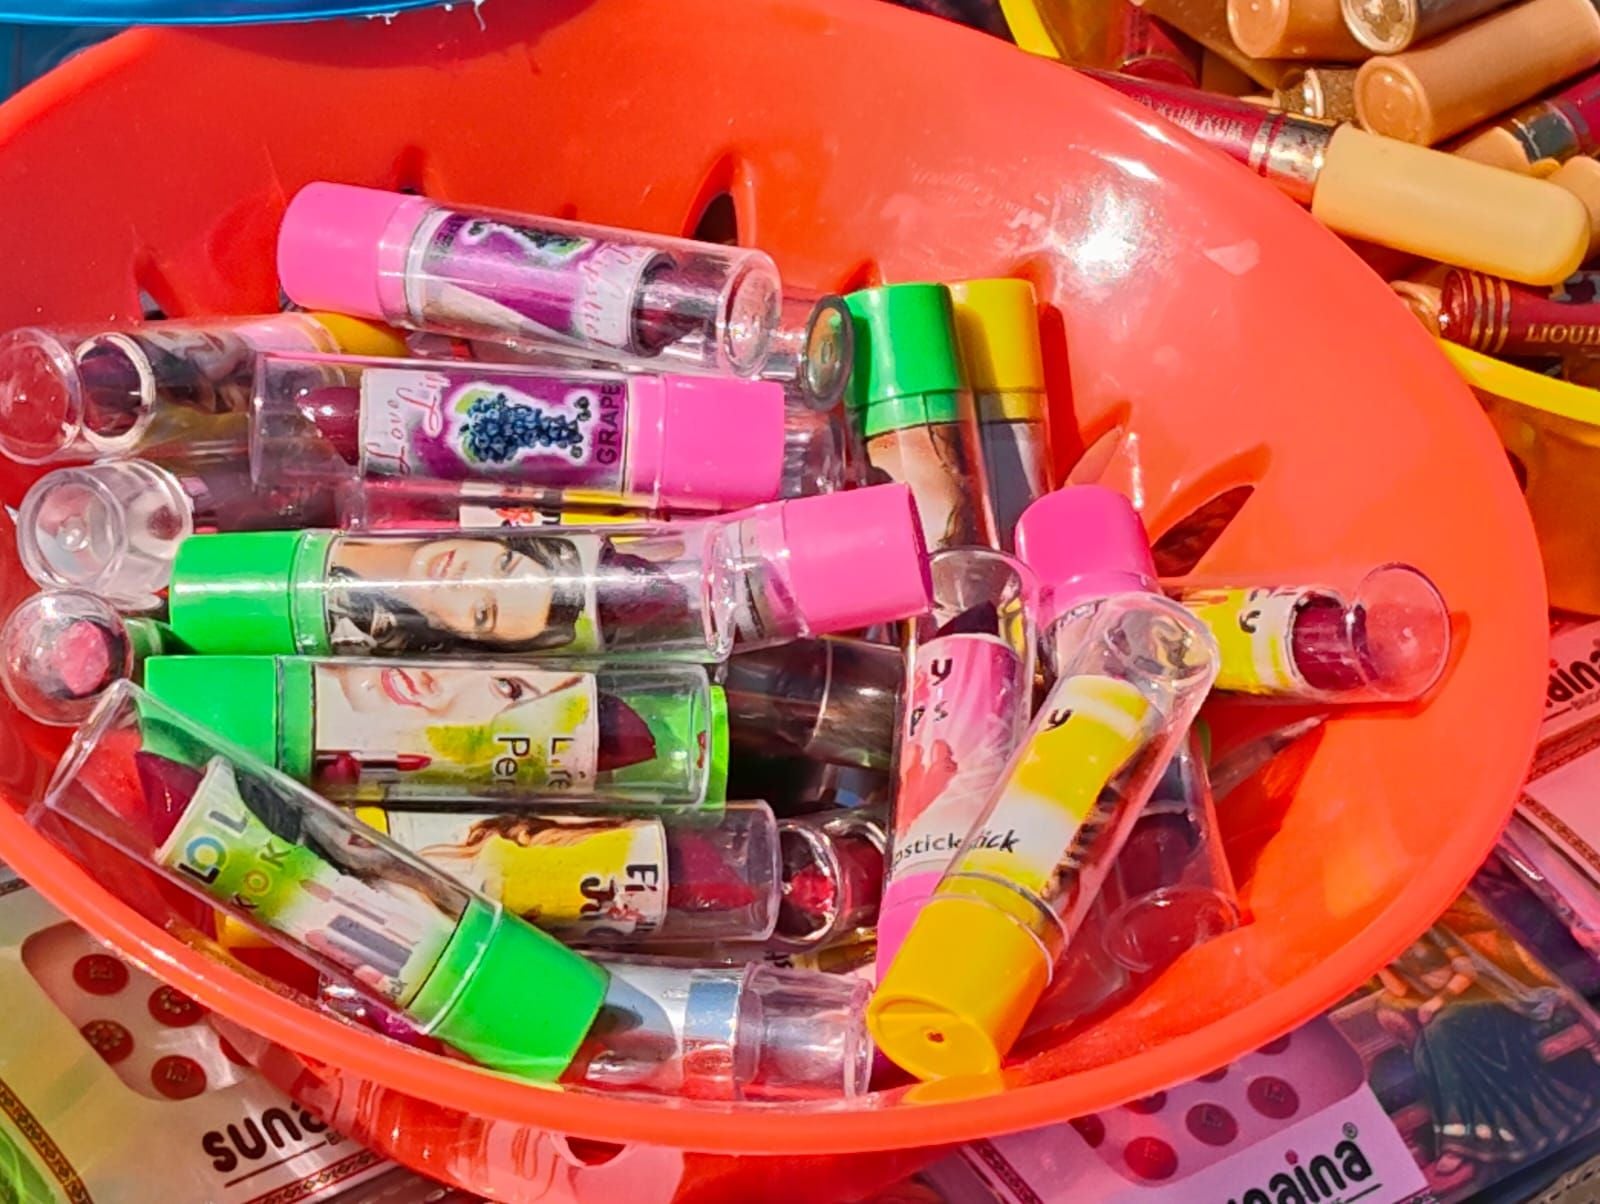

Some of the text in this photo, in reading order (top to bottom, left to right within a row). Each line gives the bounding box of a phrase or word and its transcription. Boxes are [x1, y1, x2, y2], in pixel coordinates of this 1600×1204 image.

[1525, 323, 1600, 346] LIQUI
[366, 399, 412, 475] Love
[596, 382, 622, 465] GRAPE
